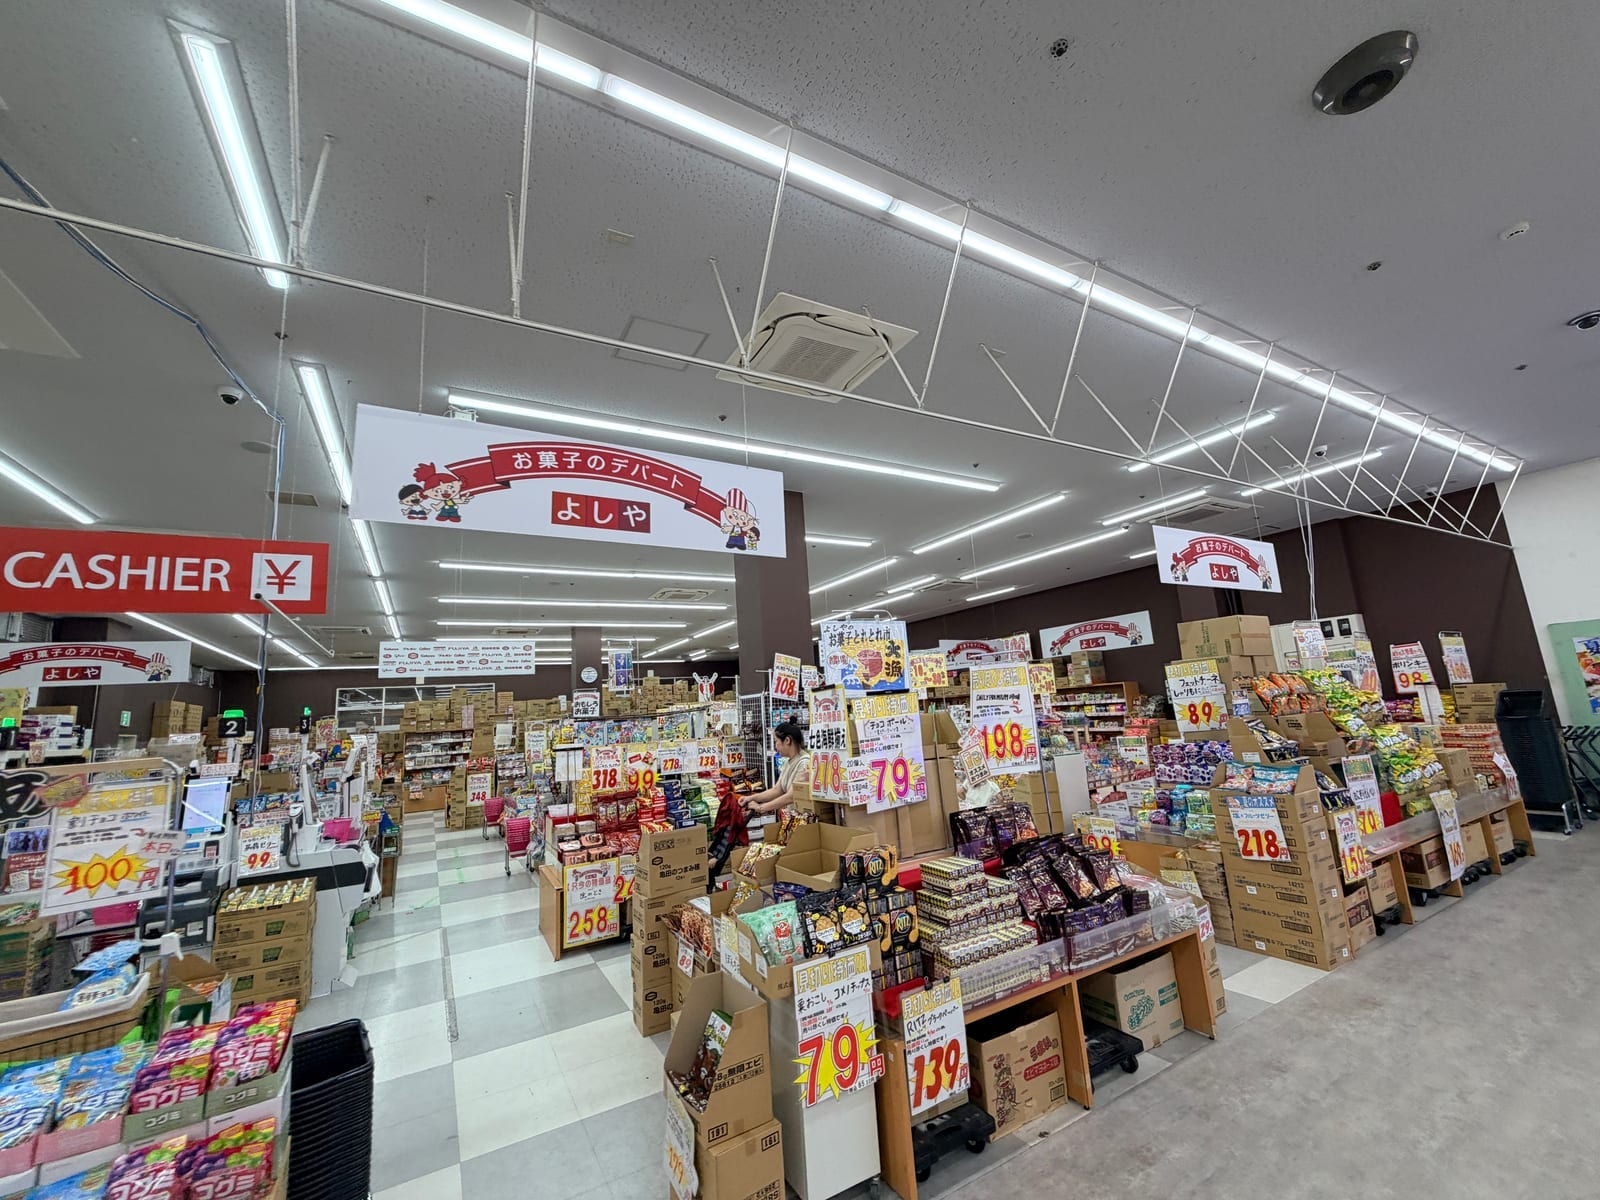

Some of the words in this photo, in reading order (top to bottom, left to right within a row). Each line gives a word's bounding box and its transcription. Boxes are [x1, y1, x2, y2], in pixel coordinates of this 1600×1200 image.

[511, 449, 685, 490] お菓子のデパート
[556, 496, 648, 530] よしや
[1194, 541, 1246, 558] お菓子のデパート
[3, 550, 231, 592] CASHIER
[1211, 565, 1238, 581] よしや
[828, 626, 891, 647] お菓子とれとれ市
[1081, 637, 1106, 650] よしや
[21, 646, 125, 662] お菓子のデパート
[45, 666, 100, 681] よしや
[774, 674, 796, 696] 108
[225, 721, 238, 735] 2
[301, 719, 307, 729] 3
[698, 746, 717, 755] DARS
[726, 752, 743, 764] 159
[663, 758, 680, 771] 278
[699, 755, 716, 767] 138
[592, 768, 618, 790] 318
[628, 768, 654, 792] 99
[470, 790, 487, 802] 348
[143, 842, 173, 855] 本日
[247, 851, 271, 870] 99
[659, 863, 700, 878] 亀田のつまみ種
[868, 861, 883, 877] RITZ
[896, 917, 911, 932] RITZ
[679, 955, 691, 969] 89
[906, 1013, 927, 1036] RITZ
[138, 1083, 200, 1113] コグミ
[224, 1087, 258, 1103] コグミ
[145, 1110, 181, 1128] コグミ
[196, 1174, 256, 1200] コグミ
